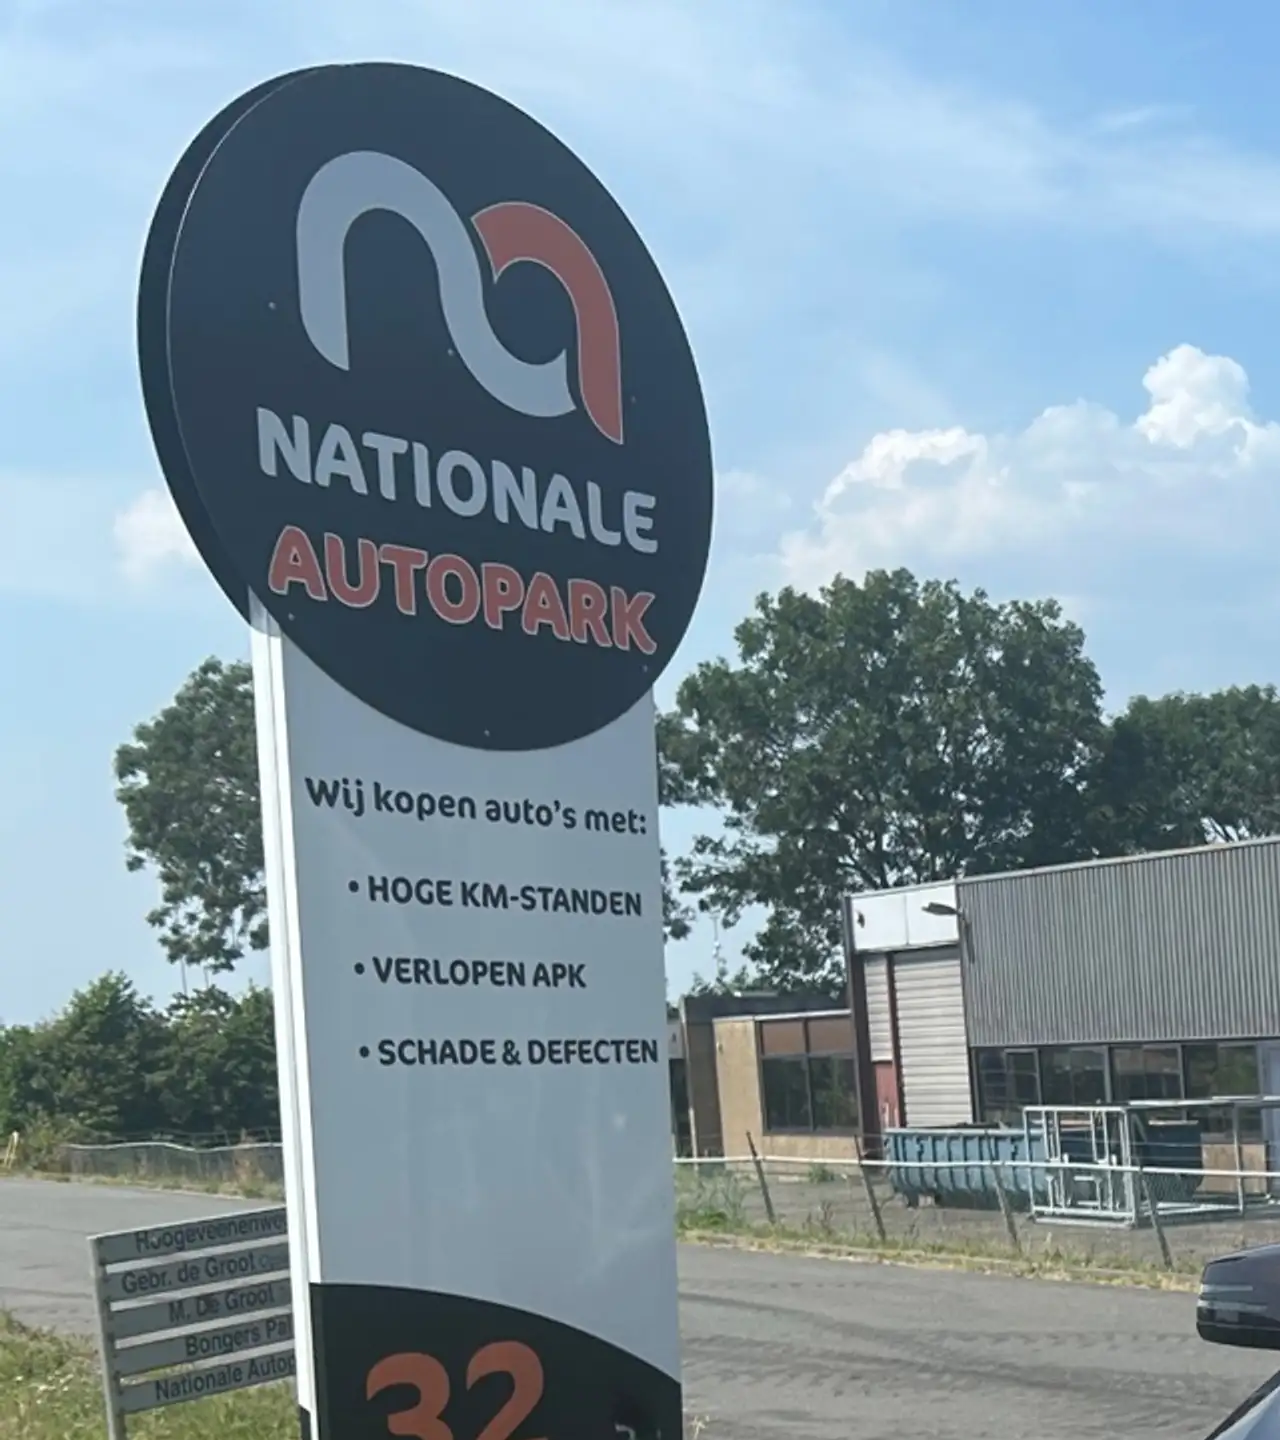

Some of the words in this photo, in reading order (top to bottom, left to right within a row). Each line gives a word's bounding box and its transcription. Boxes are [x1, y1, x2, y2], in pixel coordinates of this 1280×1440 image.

[256, 406, 659, 554] NATIONALE
[267, 524, 658, 655] AUTOPARK
[305, 777, 365, 817] Wij
[373, 782, 477, 821] kopen
[485, 798, 577, 830] auto's
[585, 808, 647, 835] met:
[367, 875, 453, 907] HOGE
[460, 881, 642, 917] KM-STANDEN
[372, 956, 526, 988] VERLOPEN
[531, 963, 587, 989] APK
[377, 1038, 497, 1067] SCHADE
[501, 1039, 522, 1066] &
[527, 1038, 659, 1065] DEFECTEN
[178, 1262, 199, 1283] de
[204, 1251, 255, 1278] Groot
[225, 1283, 276, 1310] Groot
[155, 1365, 243, 1400] Nationale
